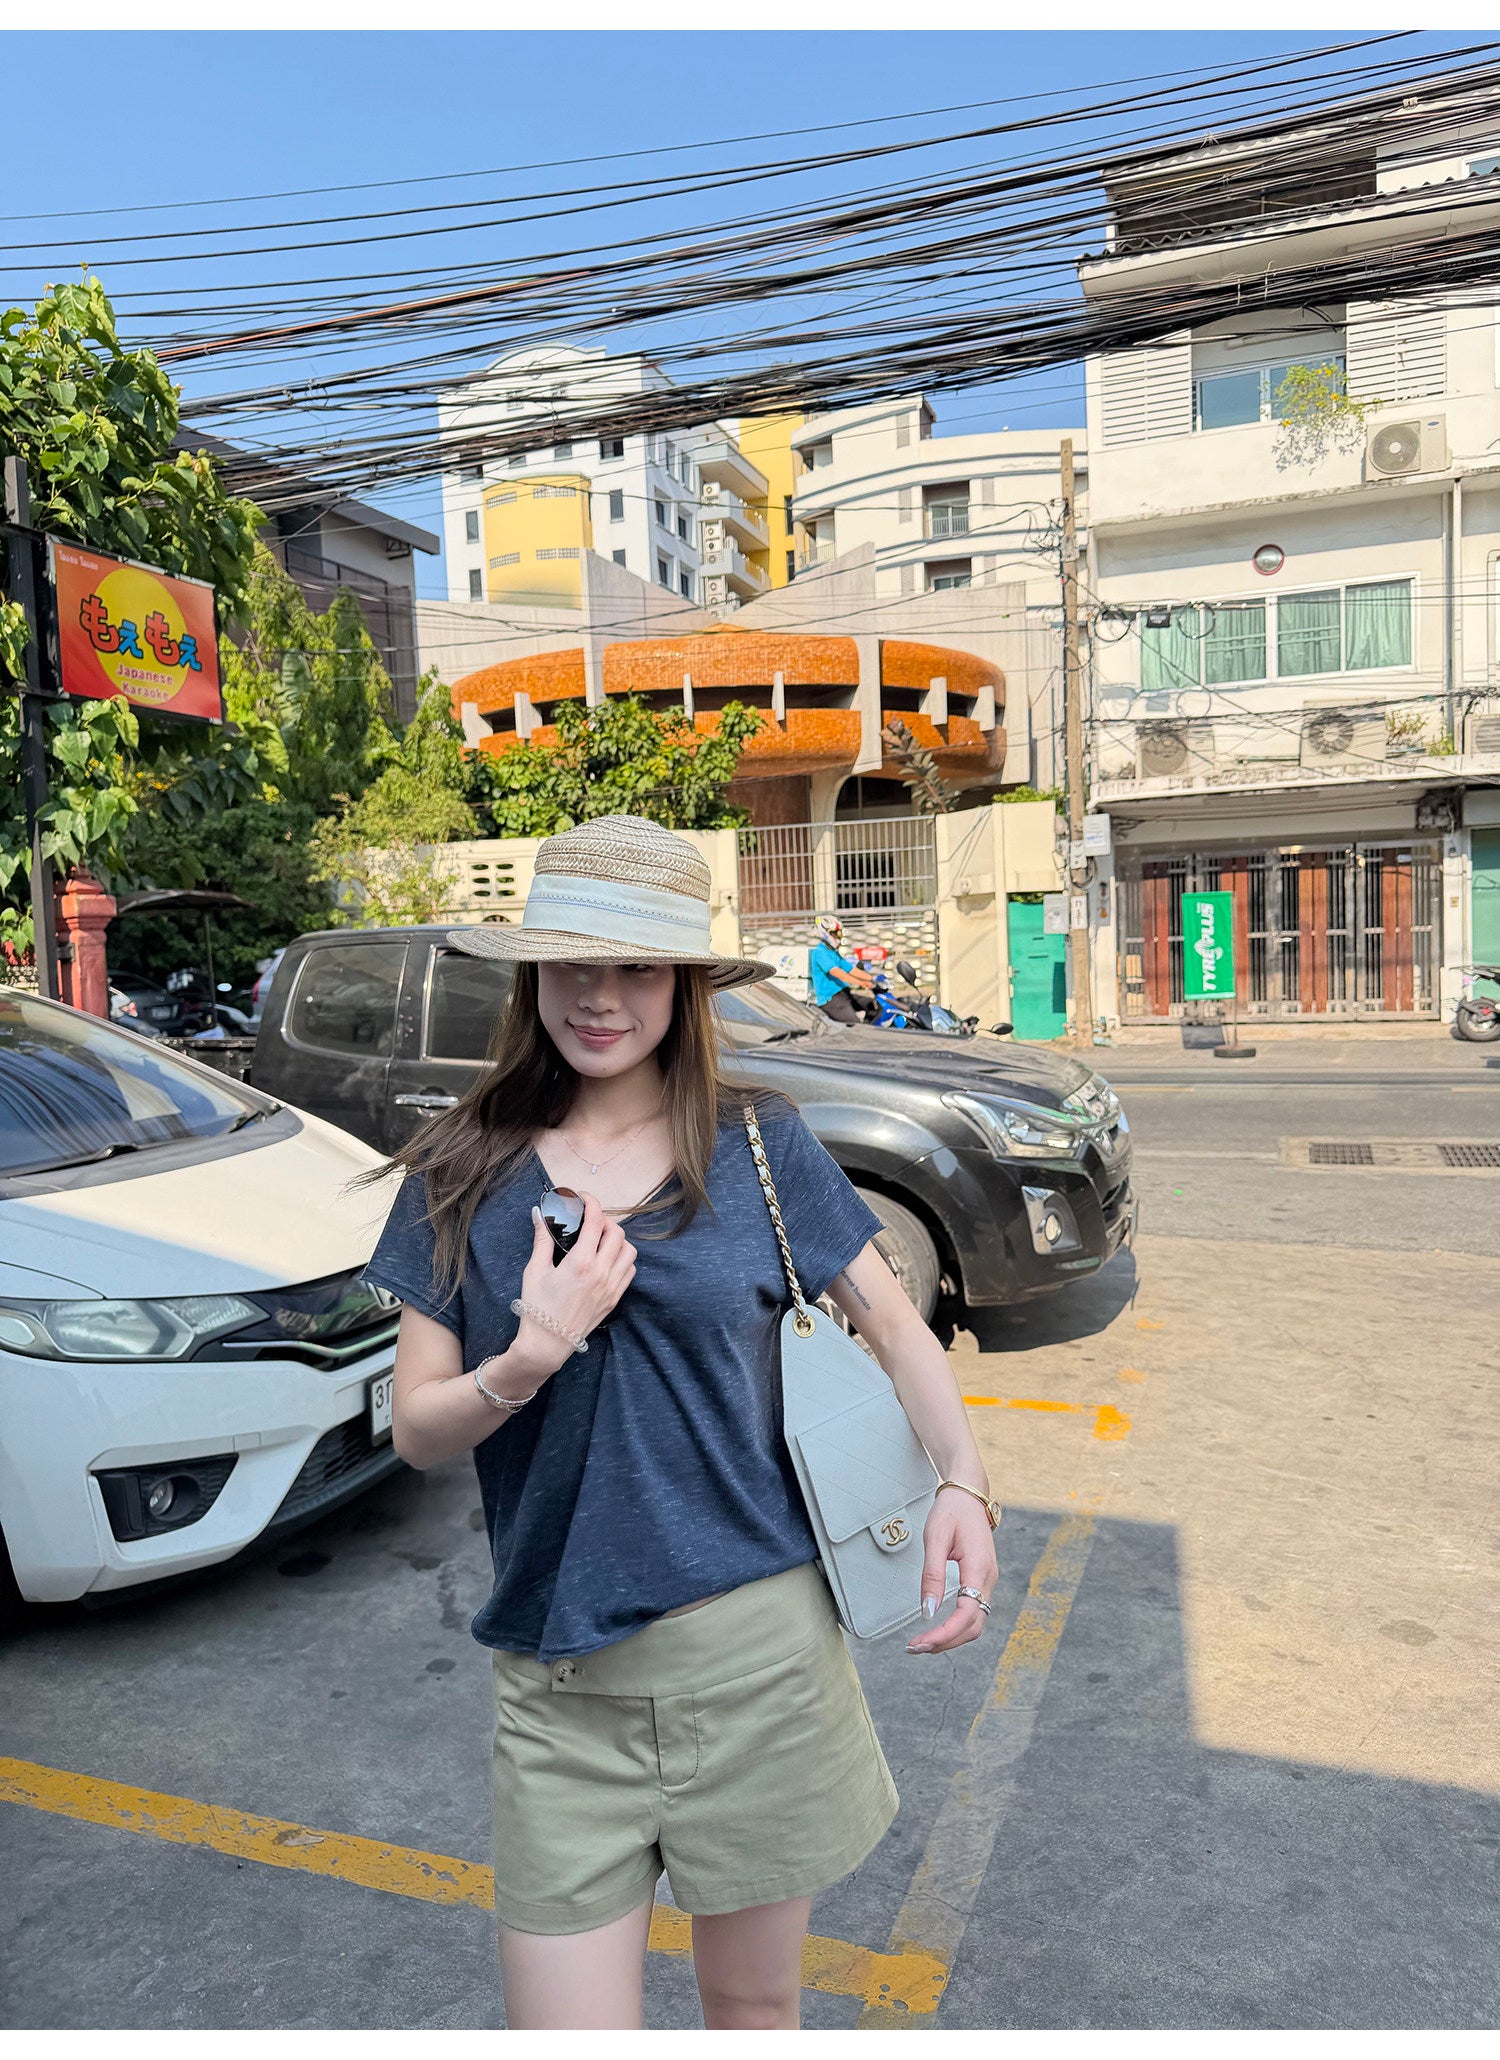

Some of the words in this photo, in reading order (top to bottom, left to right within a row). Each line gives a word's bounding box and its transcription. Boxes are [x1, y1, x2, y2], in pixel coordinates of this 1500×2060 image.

[79, 594, 202, 673] もえもえ
[117, 662, 173, 685] Japanese
[122, 682, 169, 701] Karaoke
